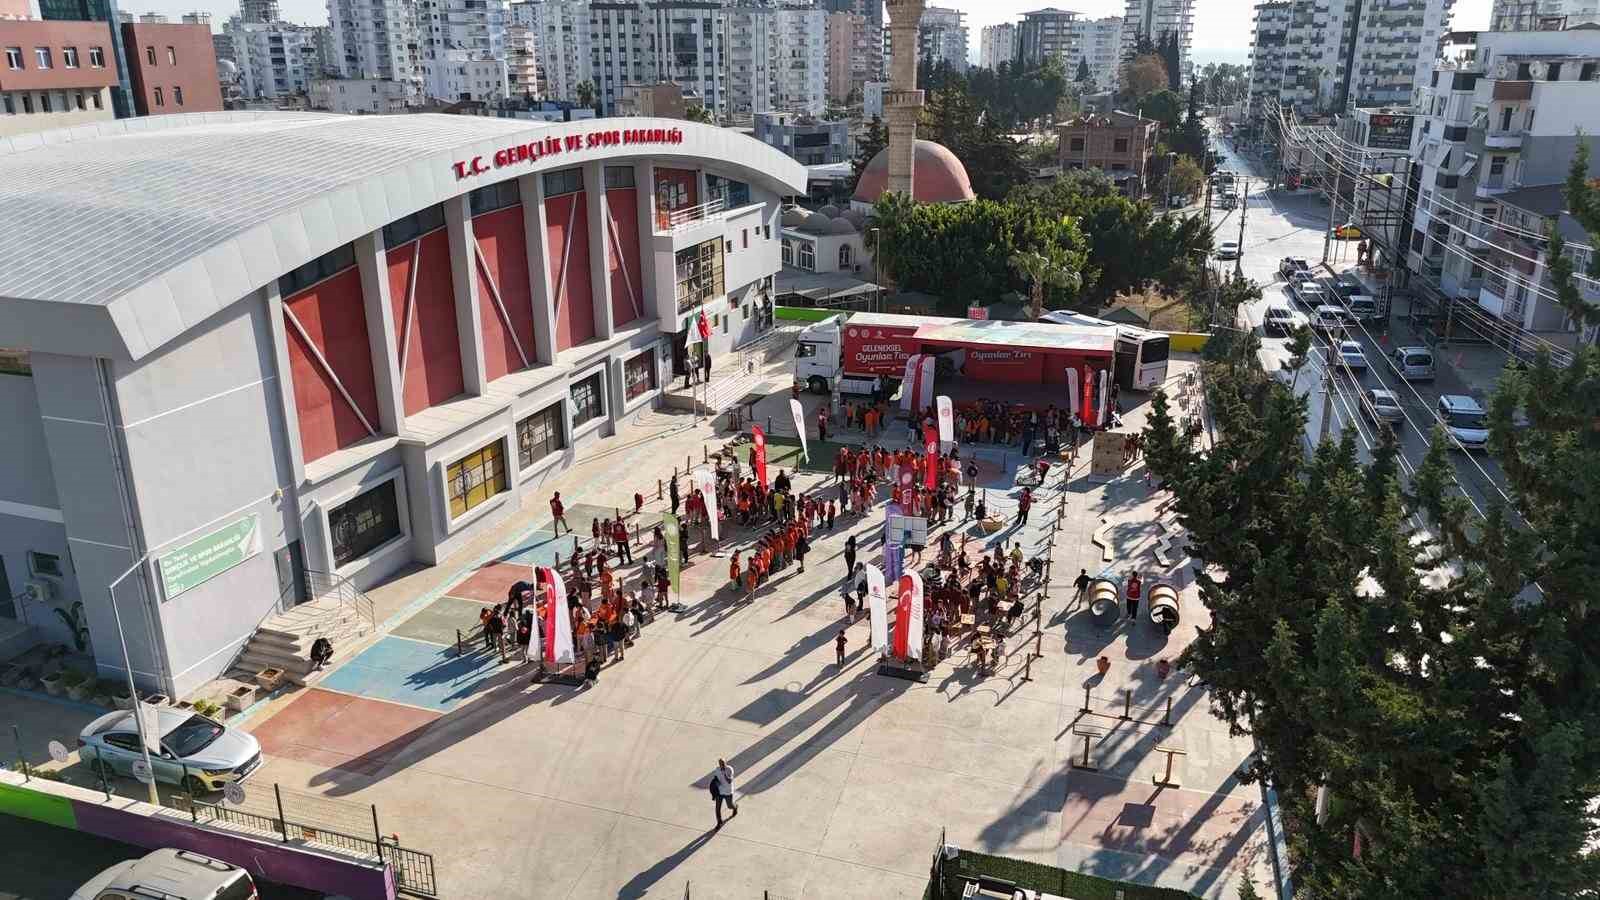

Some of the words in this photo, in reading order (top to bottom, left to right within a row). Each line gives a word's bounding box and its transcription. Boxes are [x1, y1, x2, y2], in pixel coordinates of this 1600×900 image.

[453, 157, 490, 180] T.C.
[494, 136, 562, 168] GENÇLİK
[565, 134, 583, 152] VE
[587, 130, 620, 148] SPOR
[624, 128, 682, 144] BAKANLIĞI
[855, 351, 892, 364] Oyunlar
